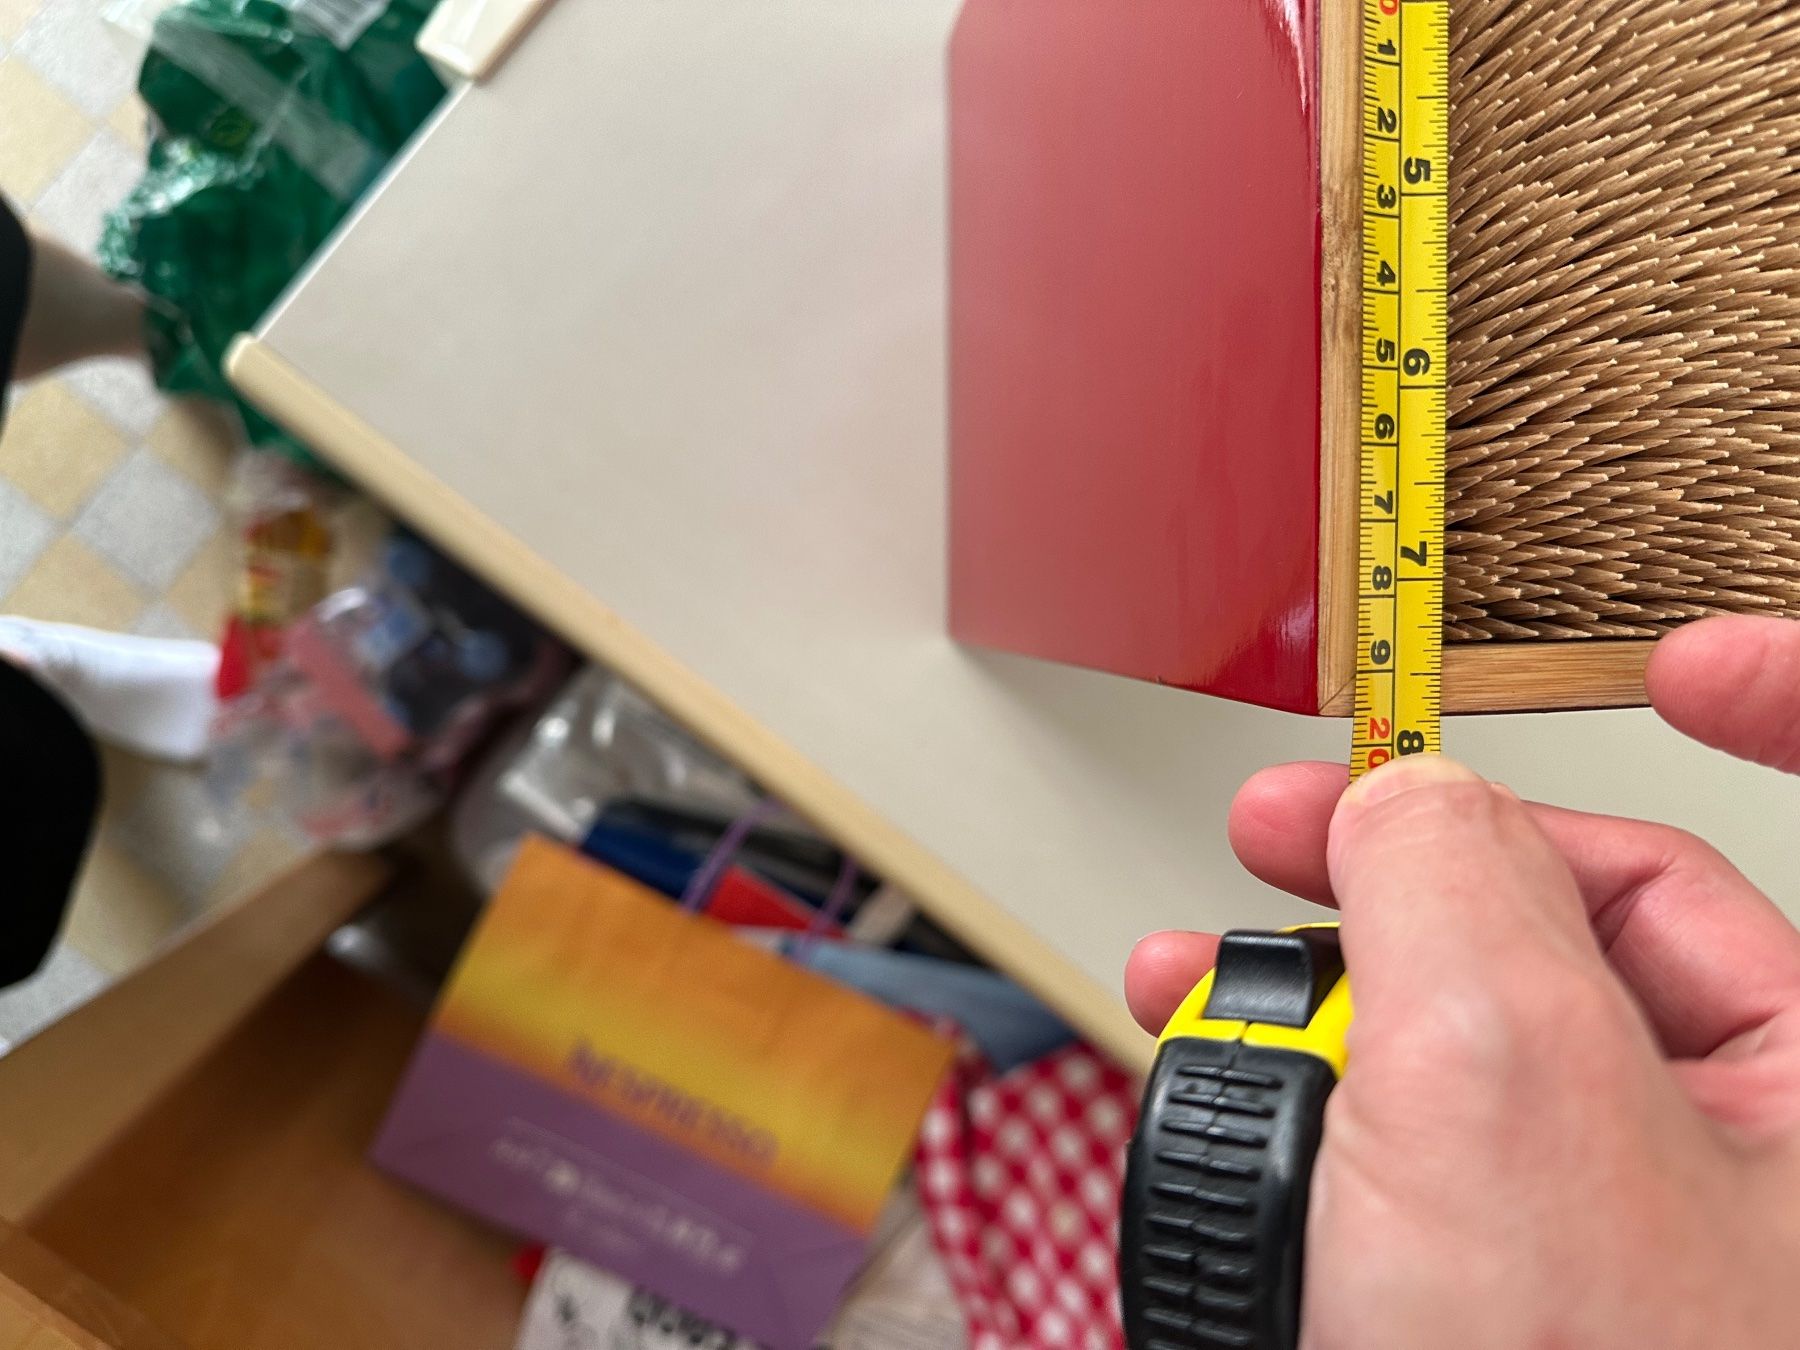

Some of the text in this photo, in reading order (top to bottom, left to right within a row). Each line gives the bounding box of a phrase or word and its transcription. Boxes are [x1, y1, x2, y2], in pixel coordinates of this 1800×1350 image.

[1377, 39, 1397, 56] 1
[1377, 106, 1397, 134] 2
[1403, 156, 1432, 185] 5
[1376, 183, 1397, 209] 3
[1376, 260, 1396, 287] 4
[1375, 337, 1396, 363] 5
[1403, 348, 1431, 377] 6
[1374, 413, 1395, 440] 6
[1373, 490, 1394, 515] 7
[1400, 540, 1428, 567] 7
[1372, 565, 1393, 591] 8
[1370, 638, 1391, 665] 9
[1396, 729, 1425, 757] 8
